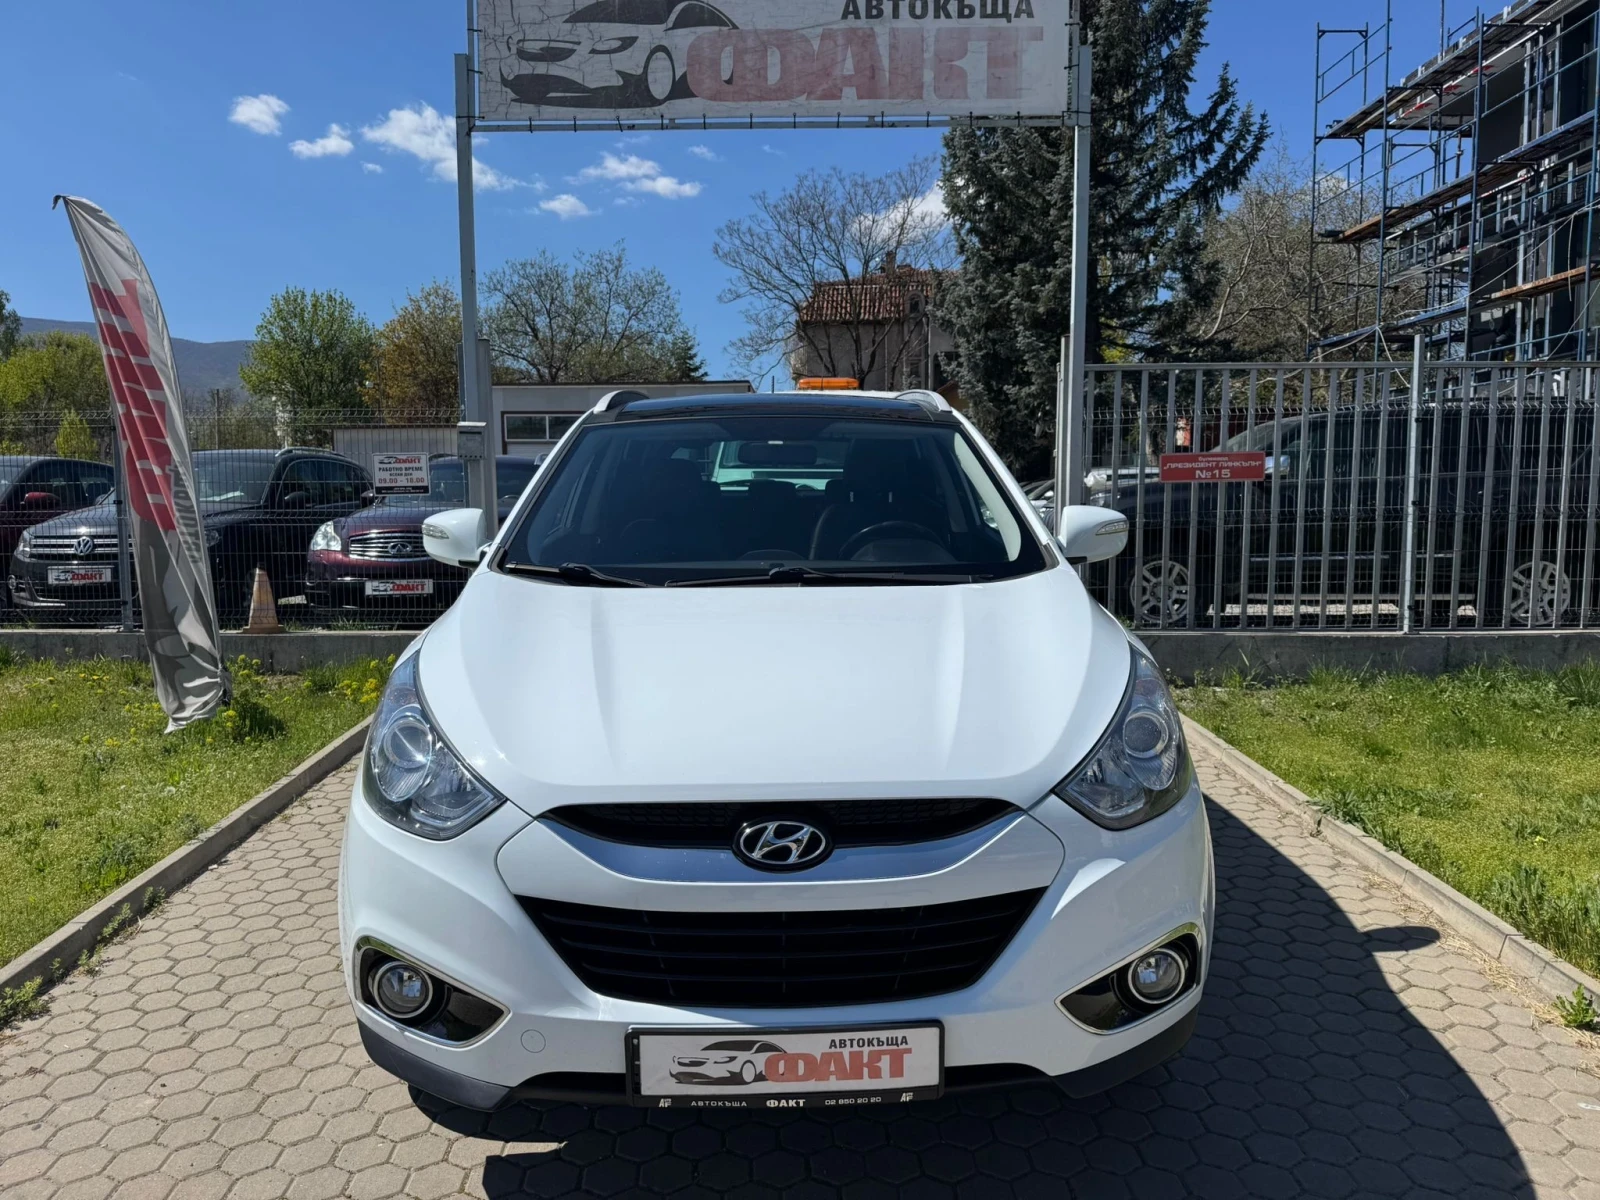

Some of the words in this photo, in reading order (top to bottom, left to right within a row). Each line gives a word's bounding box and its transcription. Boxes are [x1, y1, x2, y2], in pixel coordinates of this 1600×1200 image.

[841, 0, 1035, 23] АВТОКЪЩА
[686, 26, 1044, 101] ФАКТ
[72, 572, 104, 581] ФАКТ
[829, 1036, 908, 1049] АВТОКЪЩА
[764, 1048, 912, 1082] ФАКТ
[766, 1099, 806, 1107] ФАКТ
